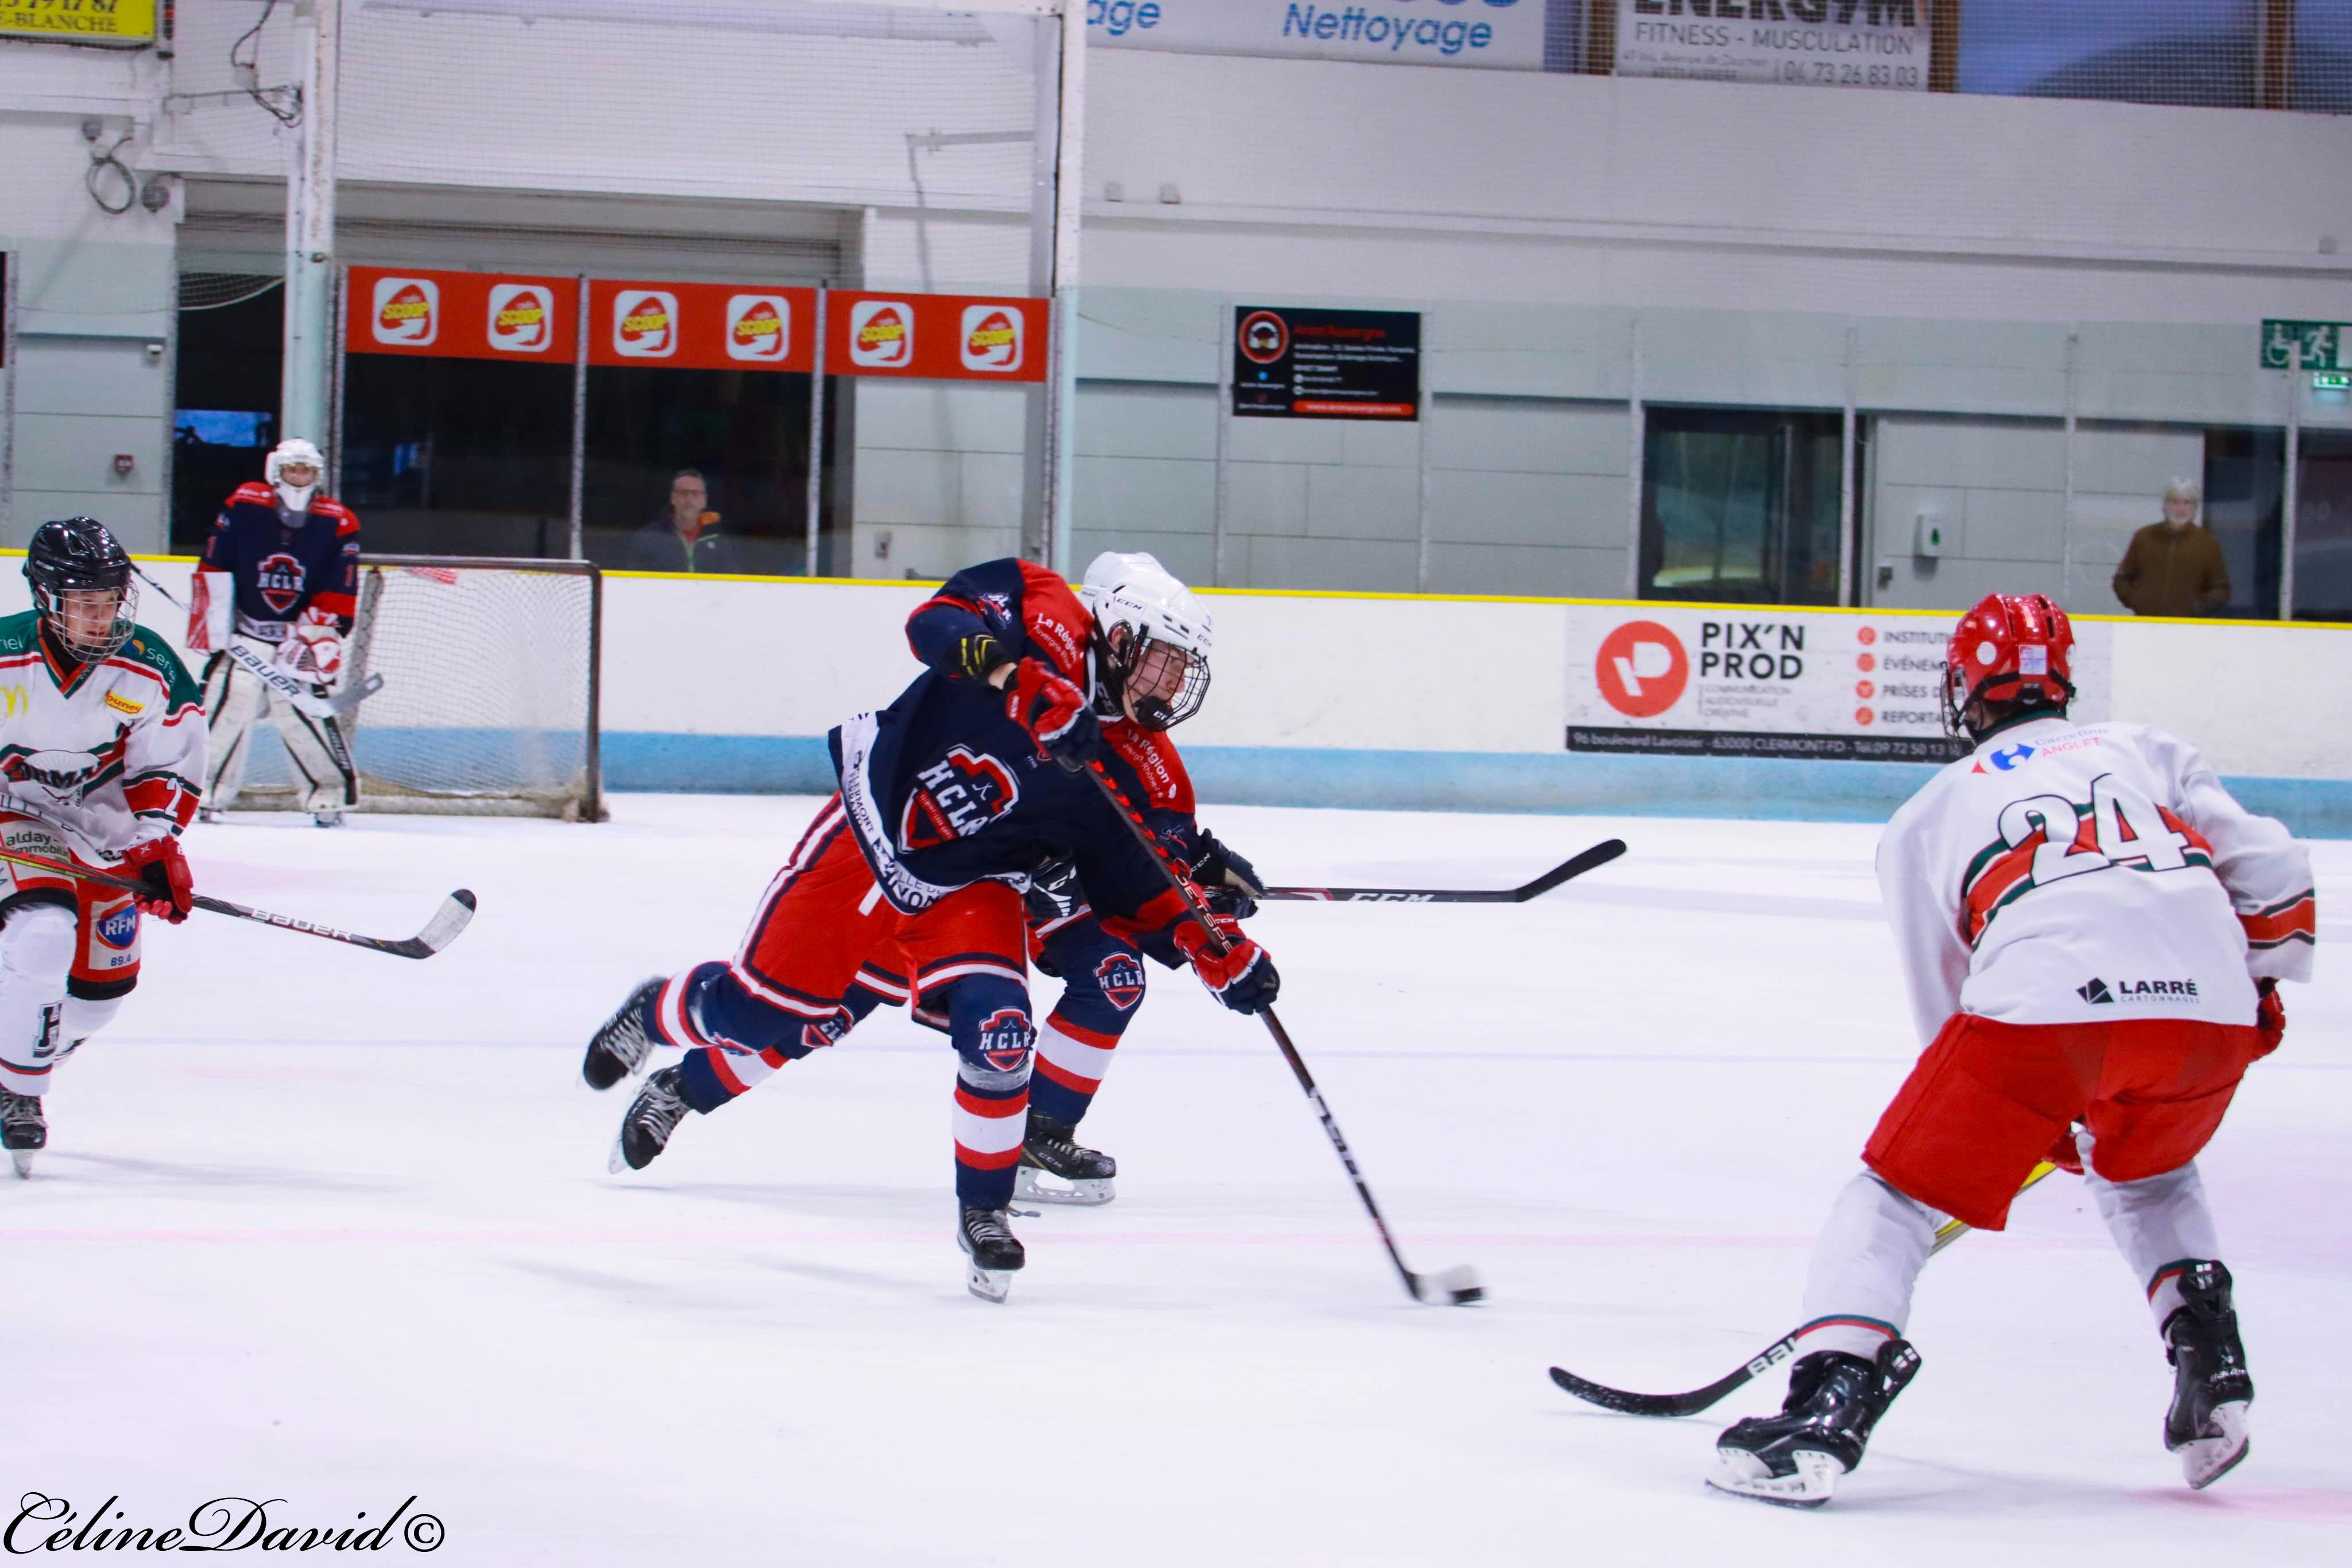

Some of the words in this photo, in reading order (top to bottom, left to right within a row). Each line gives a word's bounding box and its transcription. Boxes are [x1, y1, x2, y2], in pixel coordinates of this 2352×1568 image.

[1283, 3, 1493, 55] Nettoyage
[1635, 21, 1729, 47] FITNESS
[1752, 28, 1913, 56] MUSCULATION
[1813, 61, 1835, 83] 73
[1840, 64, 1861, 84] 26
[1868, 65, 1890, 86] 83
[1116, 598, 1143, 610] CCM
[1037, 613, 1054, 629] La
[1196, 633, 1213, 648] CCM
[230, 644, 301, 698] BAUER
[1700, 653, 1803, 680] PROD
[2034, 727, 2109, 746] Carrefour
[2041, 737, 2100, 758] ANGLET
[1139, 739, 1170, 784] Région
[916, 759, 989, 837] HCLR
[6, 831, 51, 846] alday
[1998, 772, 2192, 888] 24
[1190, 853, 1210, 873] CCM
[1348, 892, 1434, 903] CCM
[105, 914, 136, 937] RFM
[251, 908, 352, 941] BAUER
[110, 954, 131, 967] 89.4
[1098, 970, 1146, 989] HCLR
[2118, 978, 2199, 996] LARRÉ
[2120, 995, 2201, 1005] CARTONNAGES
[978, 1031, 1031, 1051] HCLR
[1038, 1151, 1063, 1170] CCM
